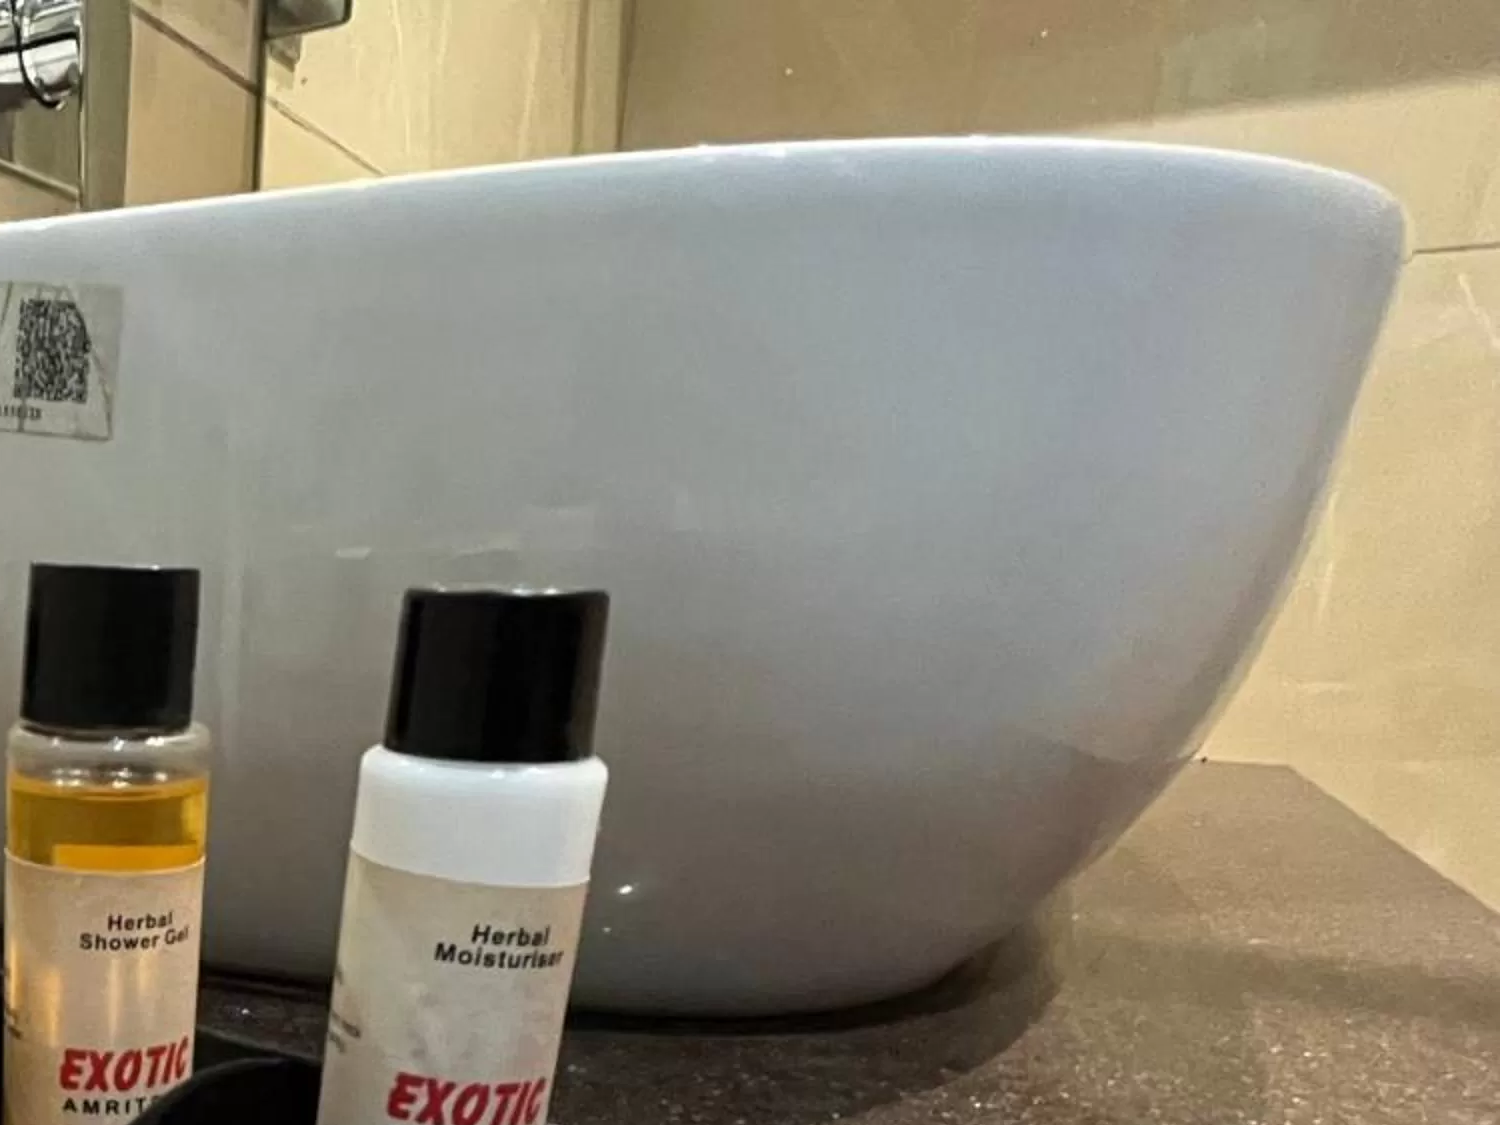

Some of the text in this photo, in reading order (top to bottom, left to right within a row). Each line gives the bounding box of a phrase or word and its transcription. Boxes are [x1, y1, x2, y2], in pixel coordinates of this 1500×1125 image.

[107, 911, 174, 932] Herbal
[79, 927, 190, 951] Shower Gel
[471, 924, 550, 947] Herbal
[434, 942, 564, 969] Moisturiser
[59, 1035, 189, 1092] EXOTIC
[63, 1095, 158, 1115] AMRIT
